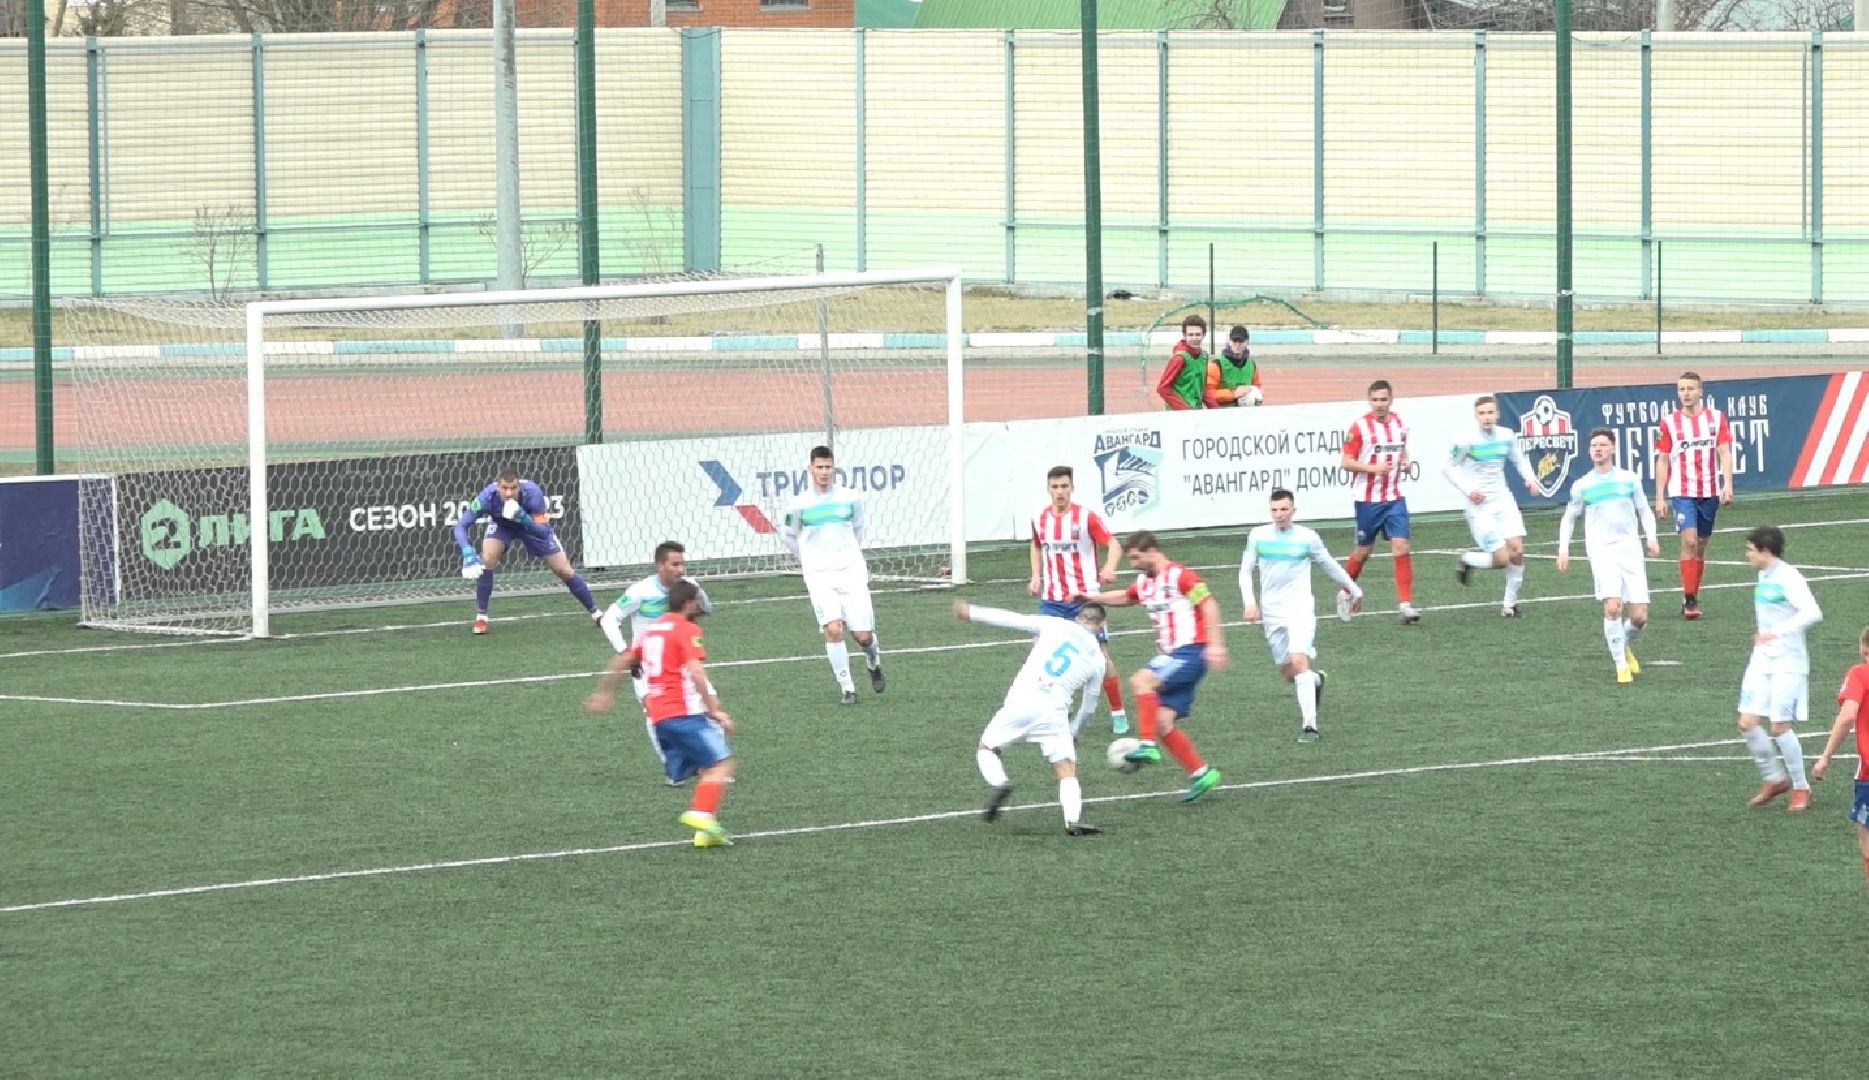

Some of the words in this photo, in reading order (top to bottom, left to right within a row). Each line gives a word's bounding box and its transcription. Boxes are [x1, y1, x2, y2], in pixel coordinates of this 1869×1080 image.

[1727, 394, 1768, 417] КЛУБ
[1094, 431, 1162, 454] АВАНГАРД
[1182, 428, 1290, 461] ГОРОДСКОЙ
[755, 464, 906, 498] ТРИОЛОР
[1183, 467, 1290, 496] "АВАНГАРД"
[349, 503, 438, 532] СЕЗОН
[1044, 641, 1080, 677] 5
